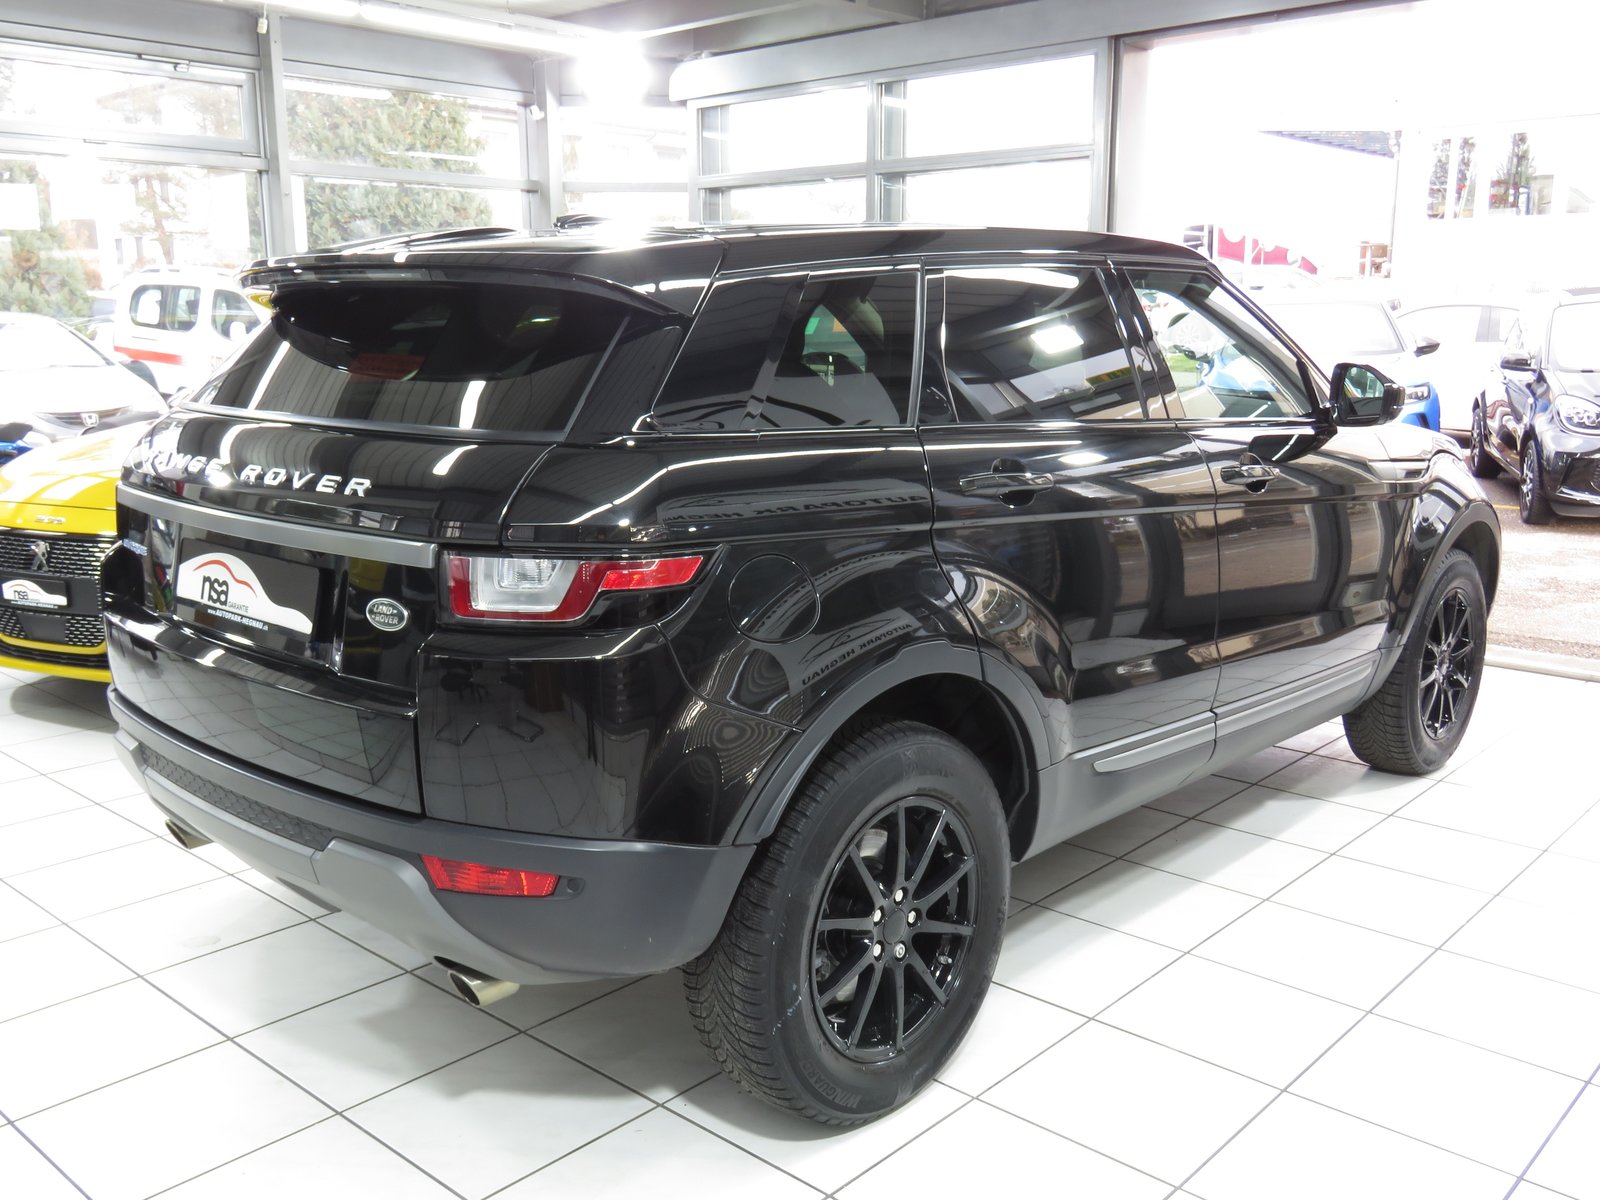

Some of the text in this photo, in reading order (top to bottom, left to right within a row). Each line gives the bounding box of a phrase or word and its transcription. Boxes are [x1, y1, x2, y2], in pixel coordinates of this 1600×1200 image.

[240, 464, 372, 497] ROVER
[201, 575, 229, 606] nsa
[228, 601, 249, 613] GARANTIE
[373, 604, 393, 615] LAND
[374, 614, 399, 624] ROVER
